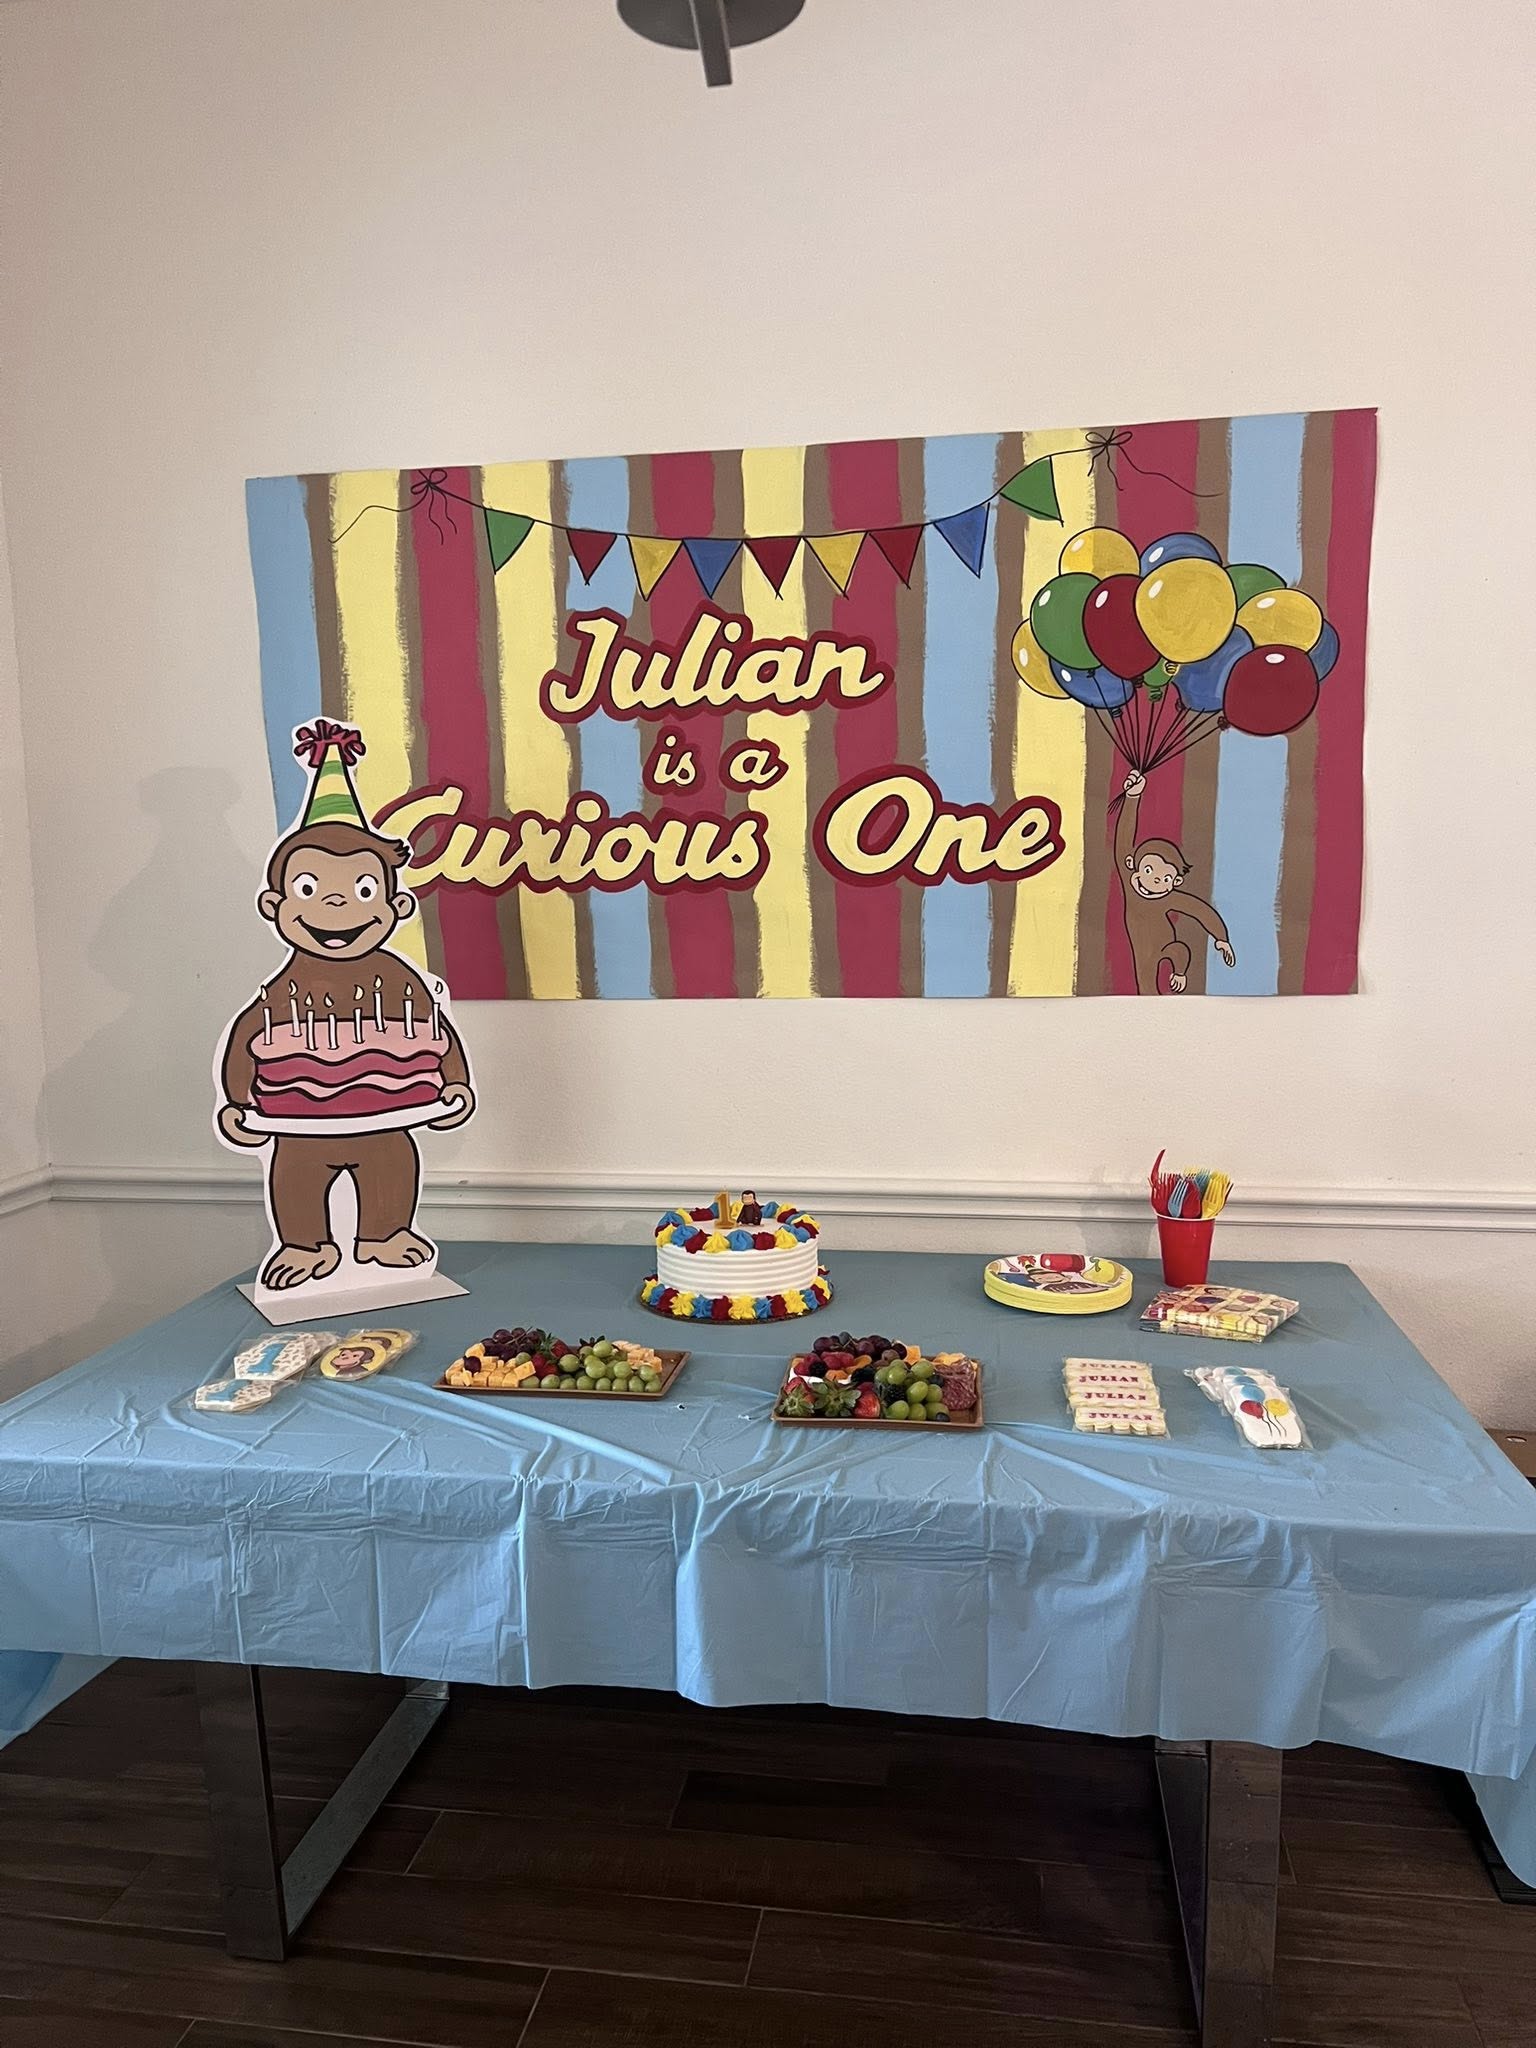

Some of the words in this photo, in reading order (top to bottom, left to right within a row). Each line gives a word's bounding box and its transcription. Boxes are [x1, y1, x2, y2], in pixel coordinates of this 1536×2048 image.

[547, 612, 886, 714] Julian
[651, 733, 698, 787] is
[727, 746, 781, 785] a
[377, 784, 762, 888] Curious
[824, 775, 1057, 876] One
[714, 1191, 737, 1229] 1
[1079, 1375, 1139, 1383] JULIAN
[1084, 1392, 1147, 1400] JULIAN
[1088, 1412, 1153, 1421] JULIAN
